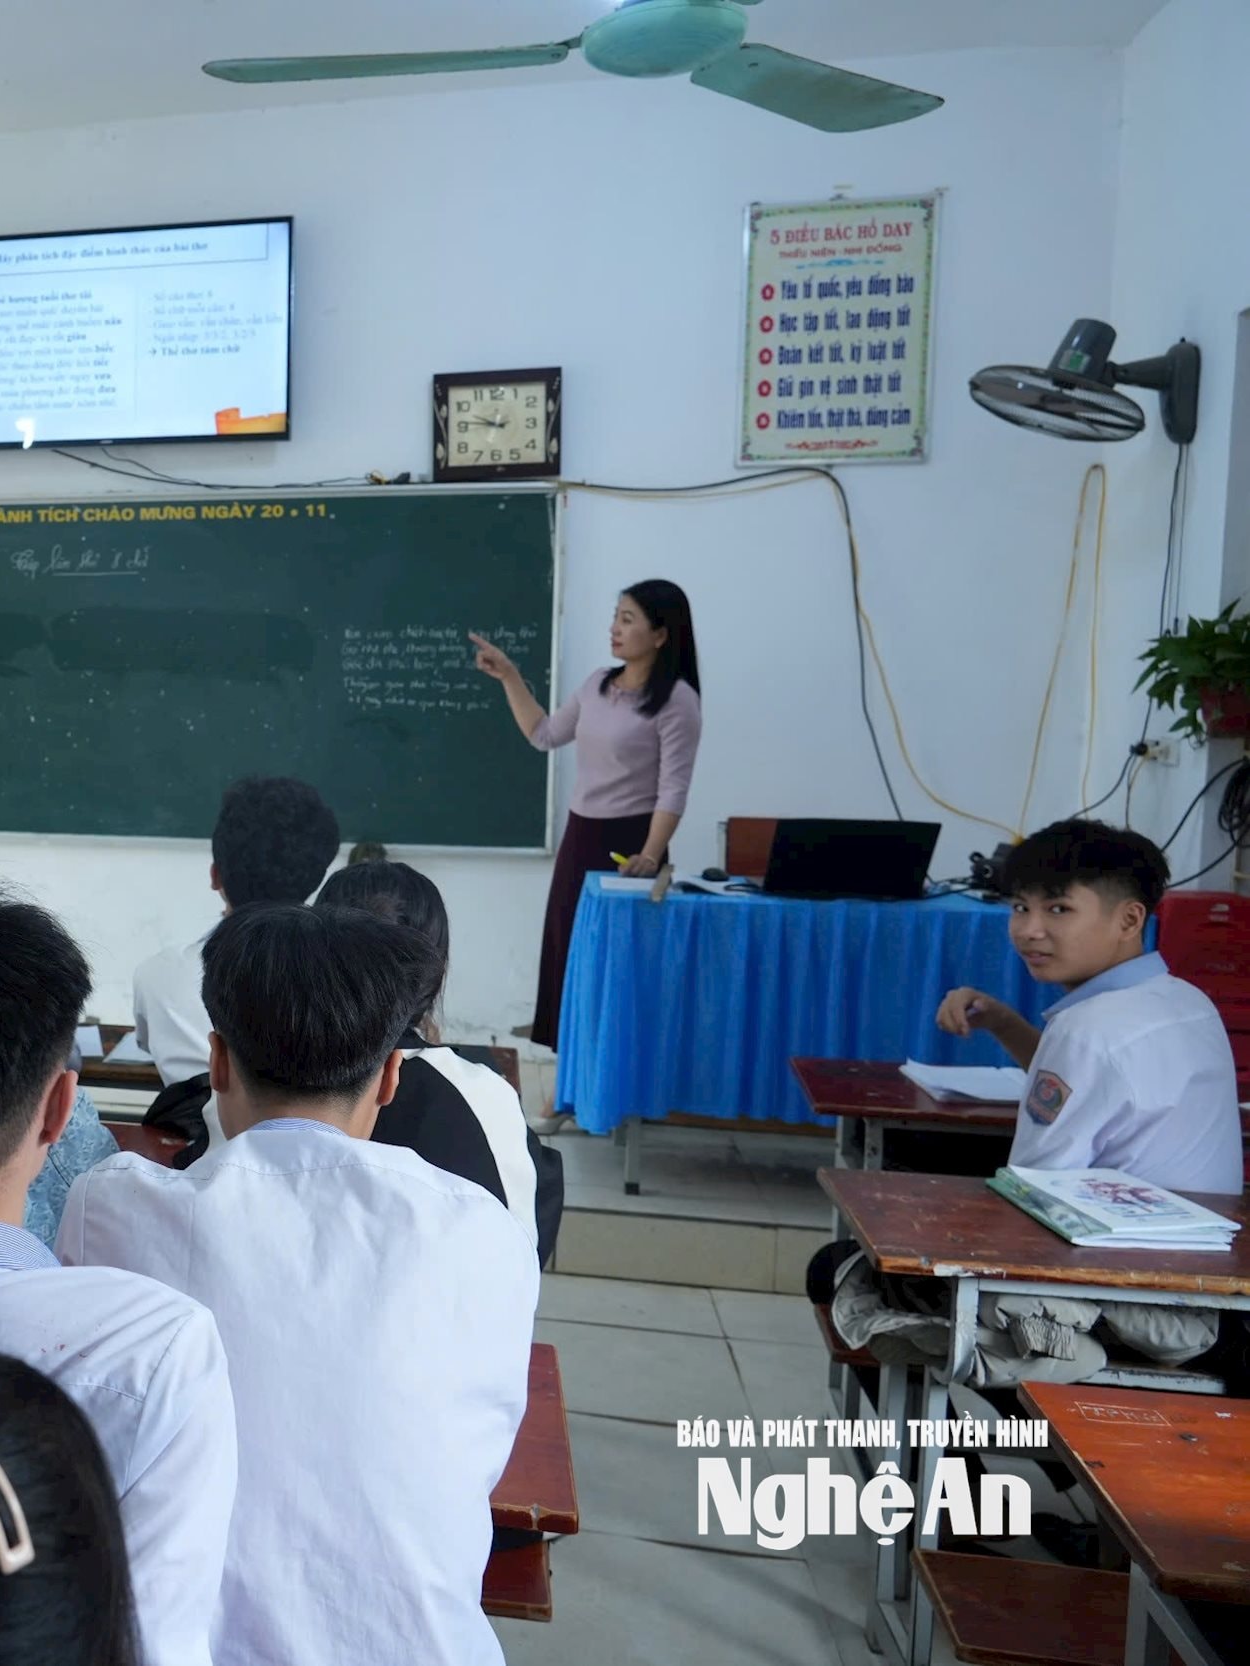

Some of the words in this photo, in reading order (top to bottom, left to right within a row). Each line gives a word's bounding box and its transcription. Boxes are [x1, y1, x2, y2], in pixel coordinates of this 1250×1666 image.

[770, 229, 780, 245] 5
[473, 389, 483, 401] 11
[489, 388, 505, 401] 12
[456, 401, 471, 413] 10
[525, 396, 538, 408] 2
[457, 421, 469, 433] 9
[525, 417, 537, 429] 3
[457, 441, 469, 454] 8
[524, 438, 537, 451] 4
[473, 450, 484, 463] 7
[490, 449, 502, 462] 6
[509, 448, 521, 461] 5
[37, 506, 79, 522] TÍCH
[201, 502, 256, 519] NGÀY
[260, 504, 284, 518] 20
[304, 503, 326, 517] 11
